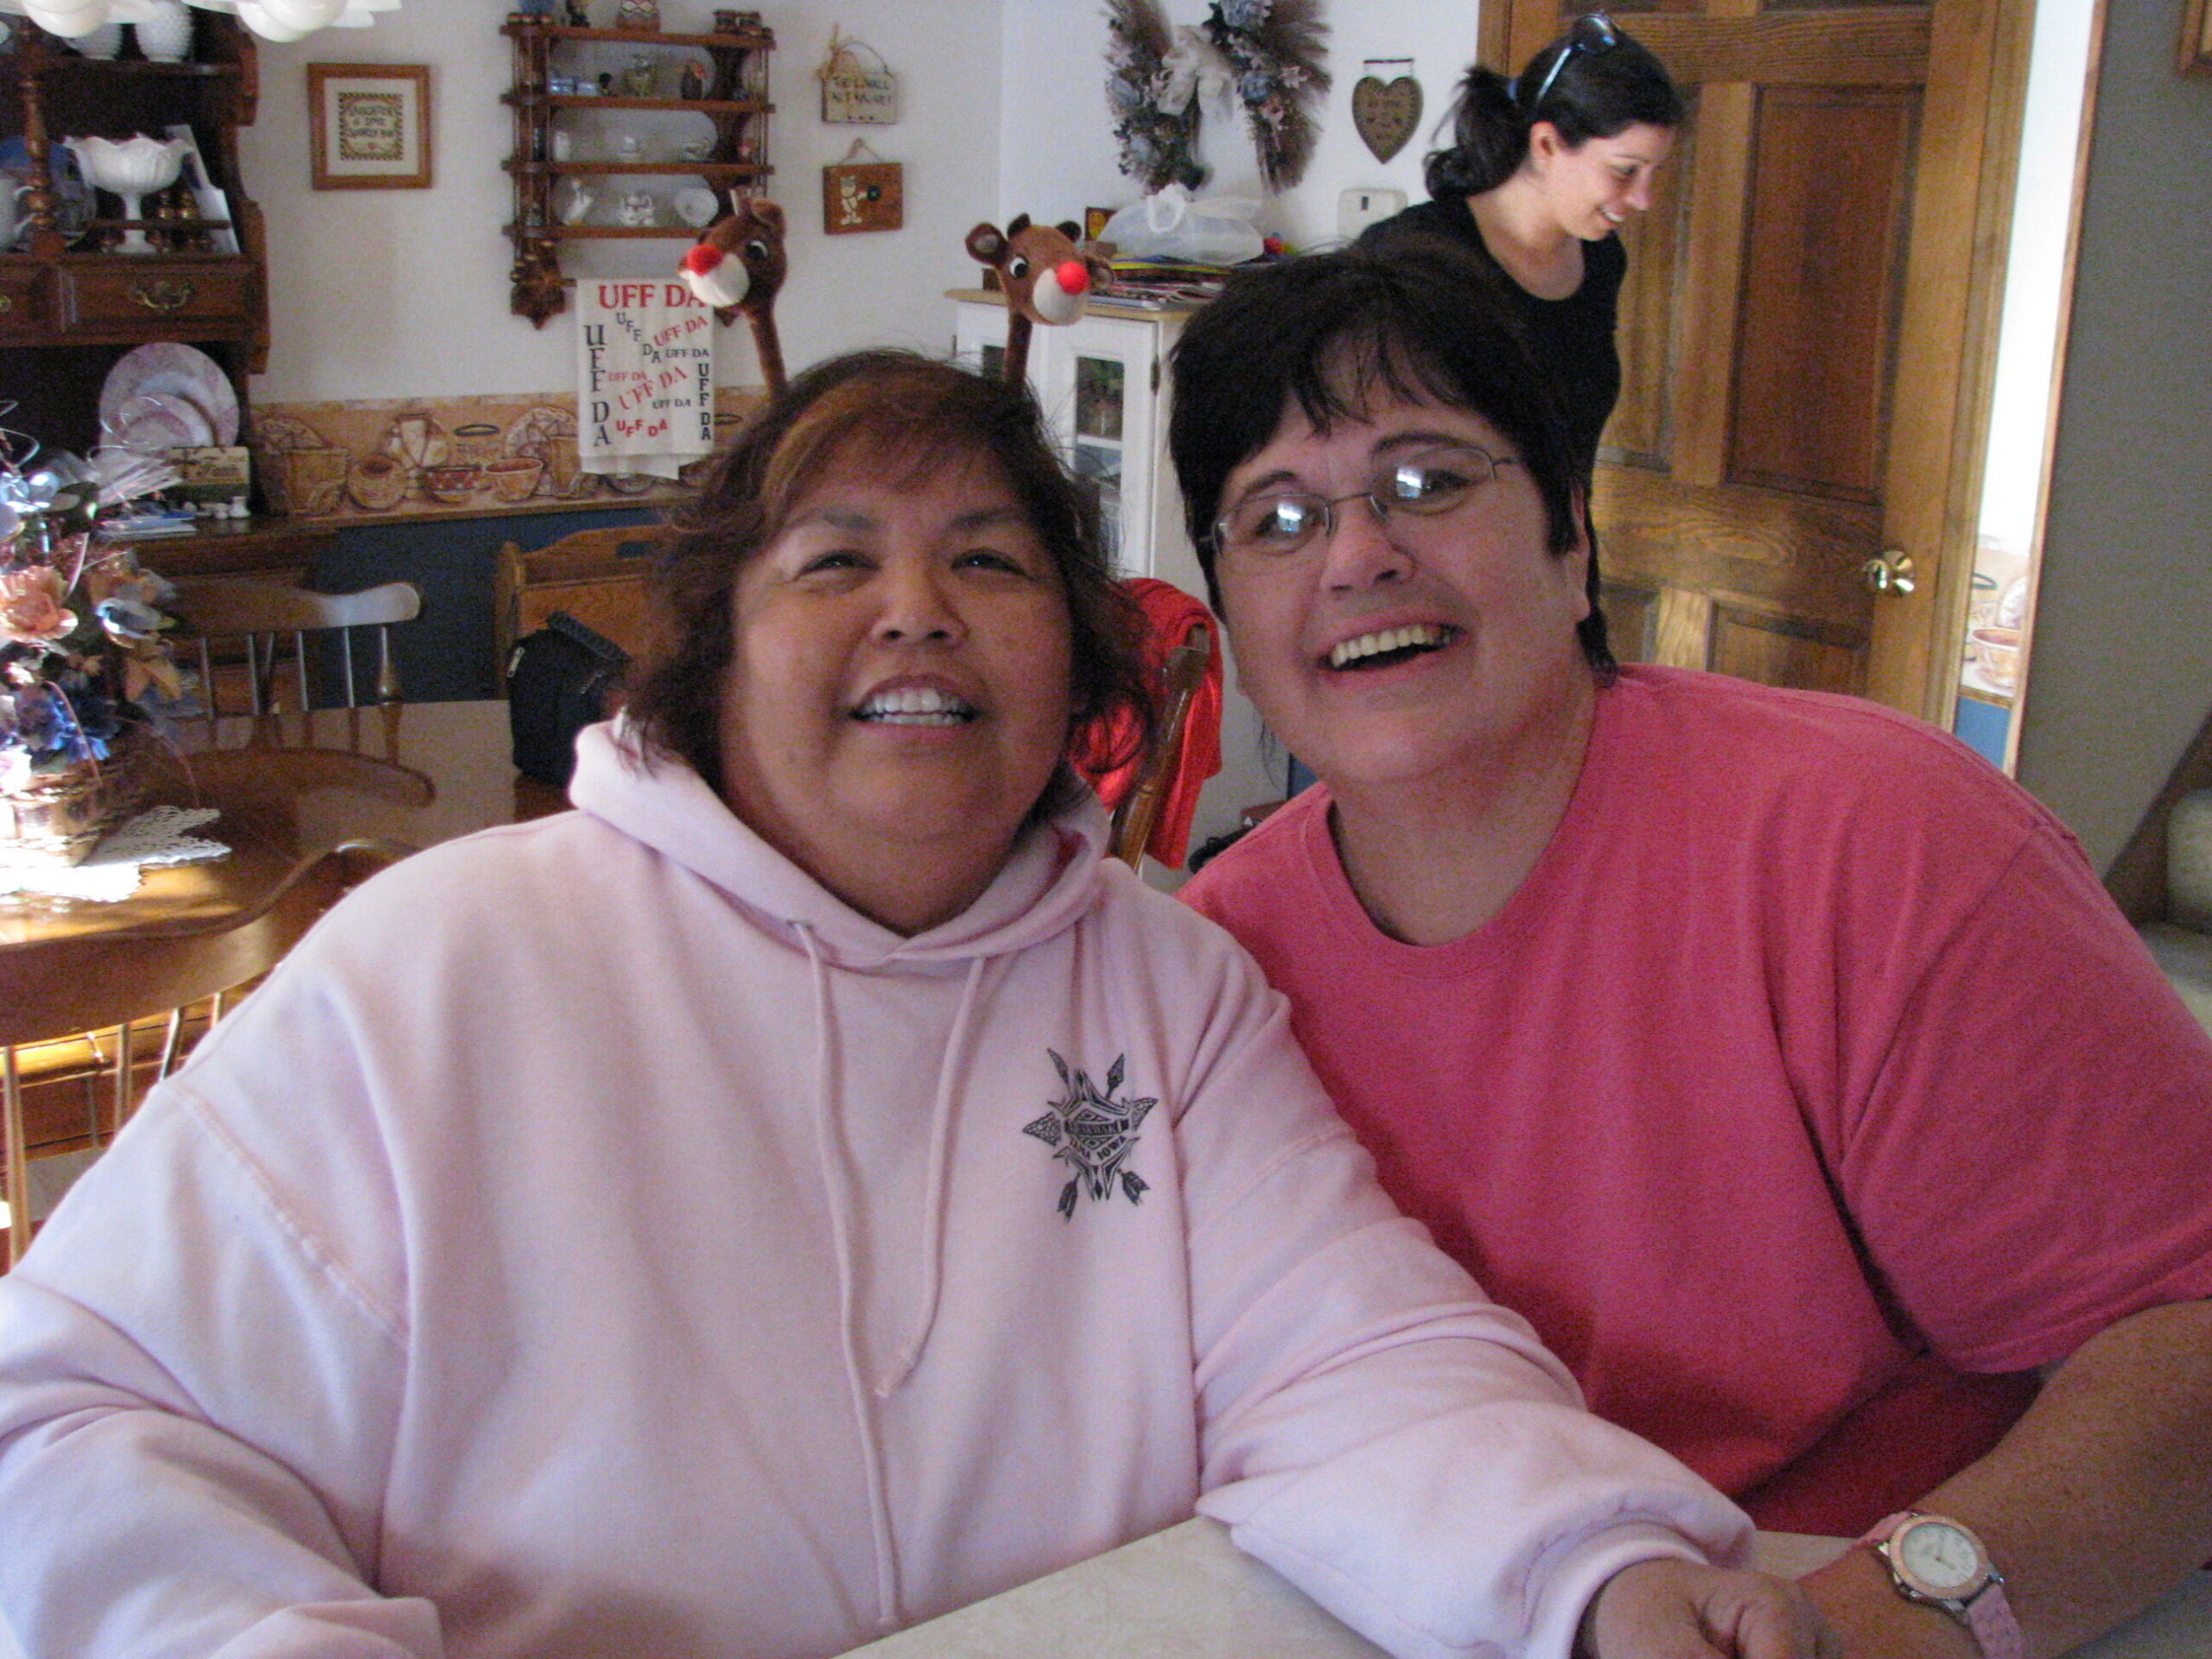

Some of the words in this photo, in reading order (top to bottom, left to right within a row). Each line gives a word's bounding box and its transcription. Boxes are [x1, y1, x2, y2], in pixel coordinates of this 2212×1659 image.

[598, 284, 654, 309] UFF
[616, 312, 642, 341] UFF
[643, 343, 662, 363] DA
[653, 325, 683, 346] UFF
[685, 315, 708, 334] DA
[583, 324, 607, 392] UFF
[665, 348, 689, 358] UFF
[692, 348, 709, 358] DA
[698, 363, 710, 406] UFF
[592, 401, 613, 448] DA
[616, 419, 644, 438] UFF
[647, 418, 668, 437] DA
[700, 411, 711, 441] DA
[1096, 1135, 1127, 1160] IOWA
